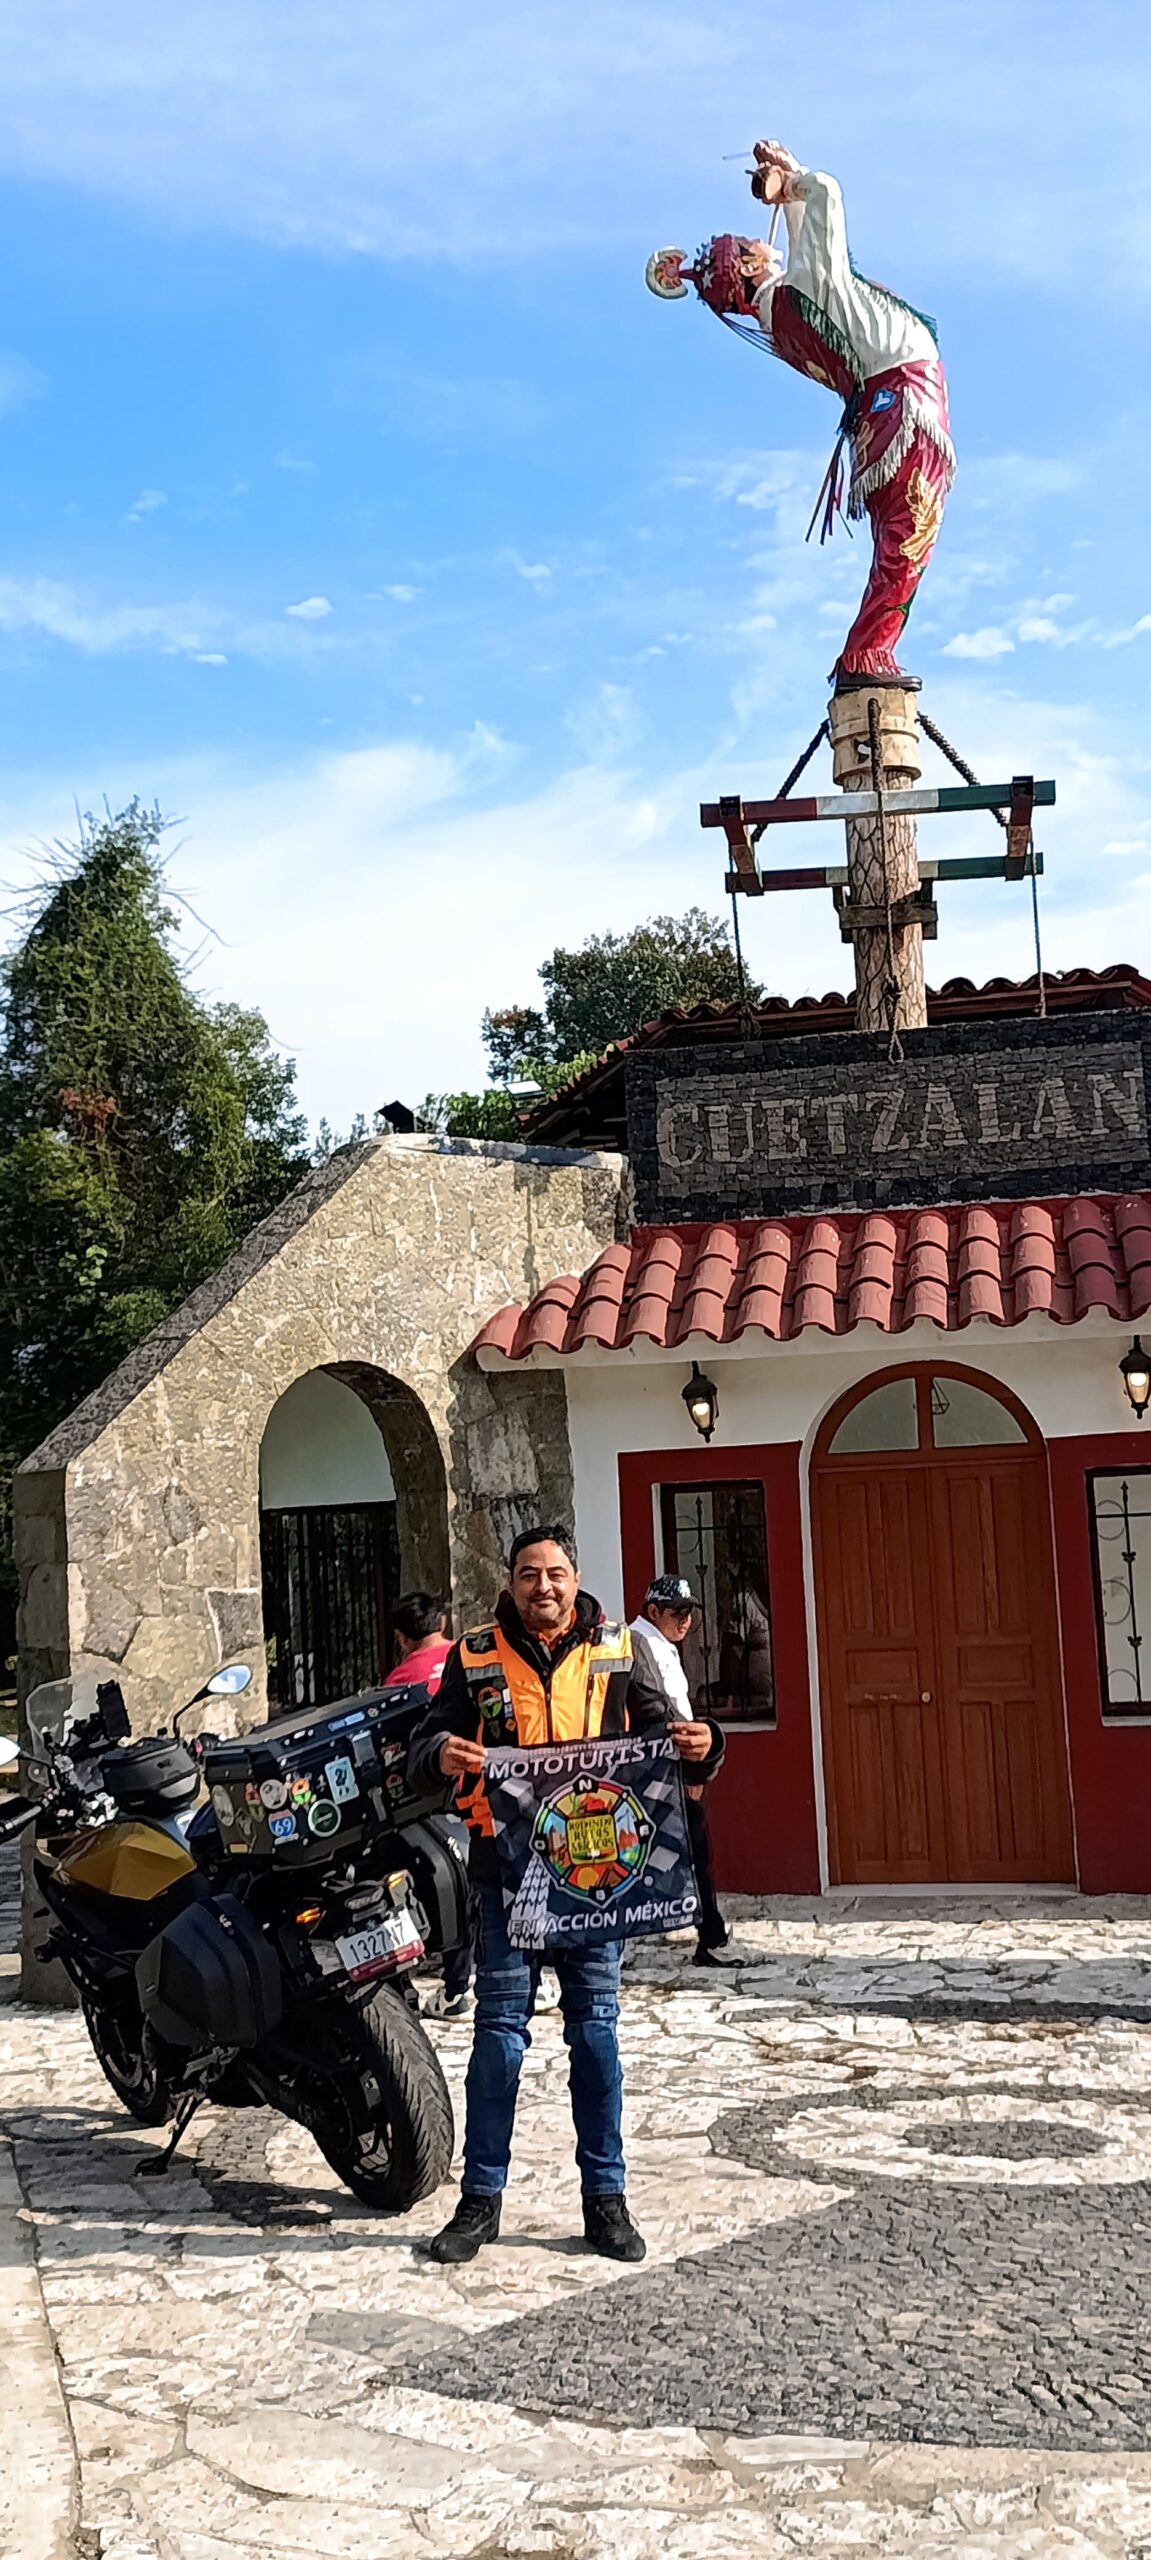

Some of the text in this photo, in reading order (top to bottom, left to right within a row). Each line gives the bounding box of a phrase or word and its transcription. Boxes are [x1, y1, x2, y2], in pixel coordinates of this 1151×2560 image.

[656, 1067, 1143, 1169] CUETZALAN
[488, 1736, 677, 1780] MOTOTURISTA
[578, 1778, 593, 1791] N
[274, 1818, 293, 1836] 69
[511, 1920, 535, 1935] EN
[544, 1909, 618, 1934] ACCIÓN
[625, 1895, 698, 1924] MÉXICO
